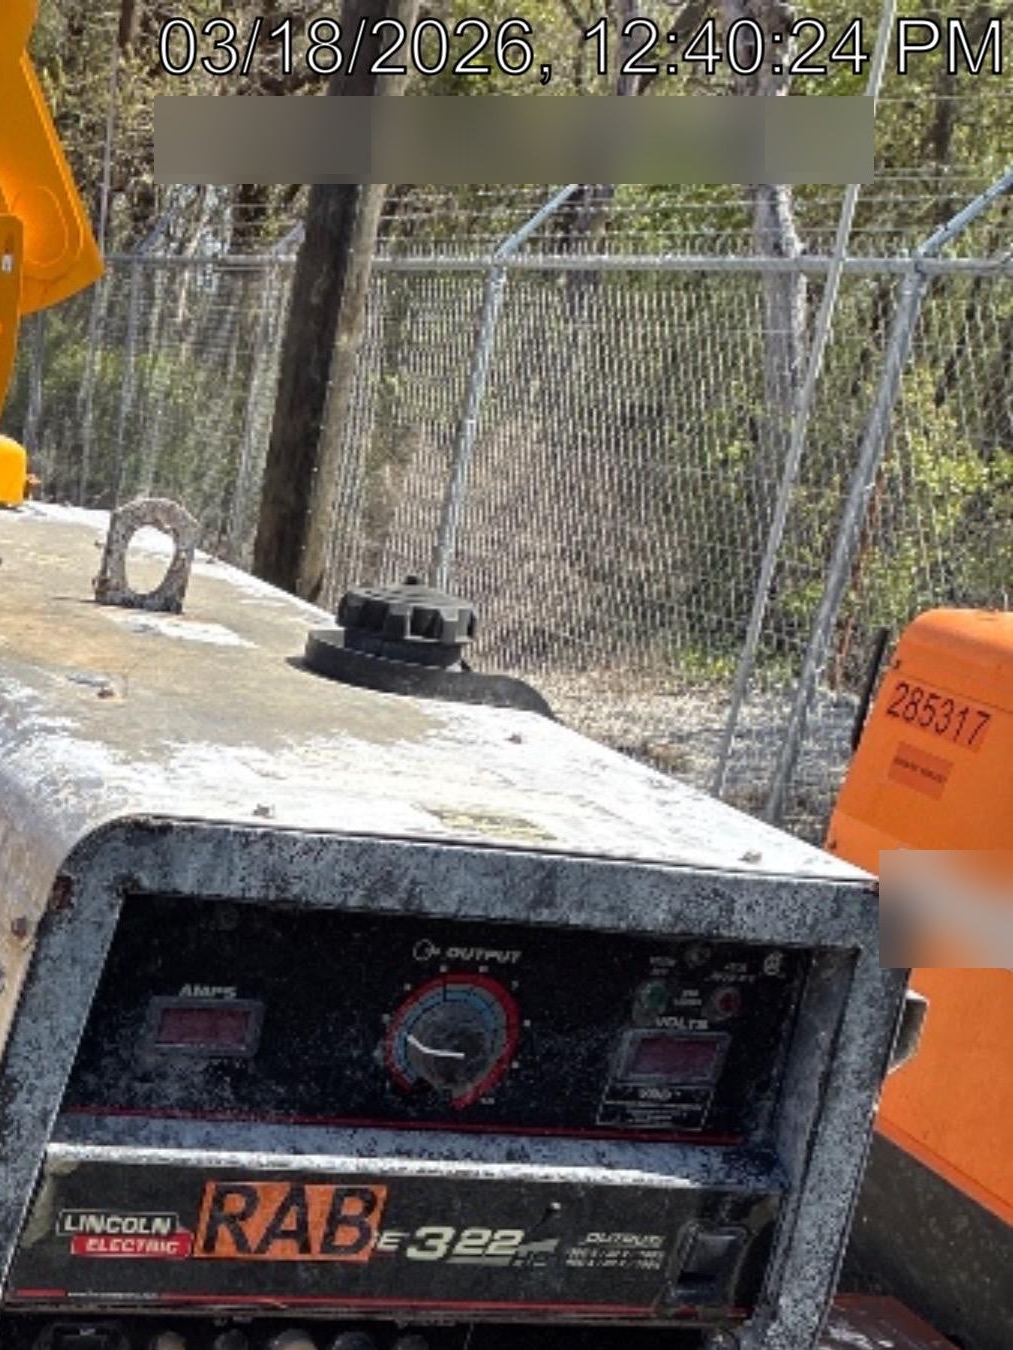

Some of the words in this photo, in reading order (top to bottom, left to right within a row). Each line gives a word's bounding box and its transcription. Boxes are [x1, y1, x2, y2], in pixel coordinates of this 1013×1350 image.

[886, 680, 990, 746] 285317
[445, 946, 524, 964] OUTPUT
[64, 1213, 173, 1235] LINCOLN
[202, 1184, 376, 1256] RAB
[84, 1237, 181, 1255] ELECTRIC
[405, 1225, 525, 1262] 322
